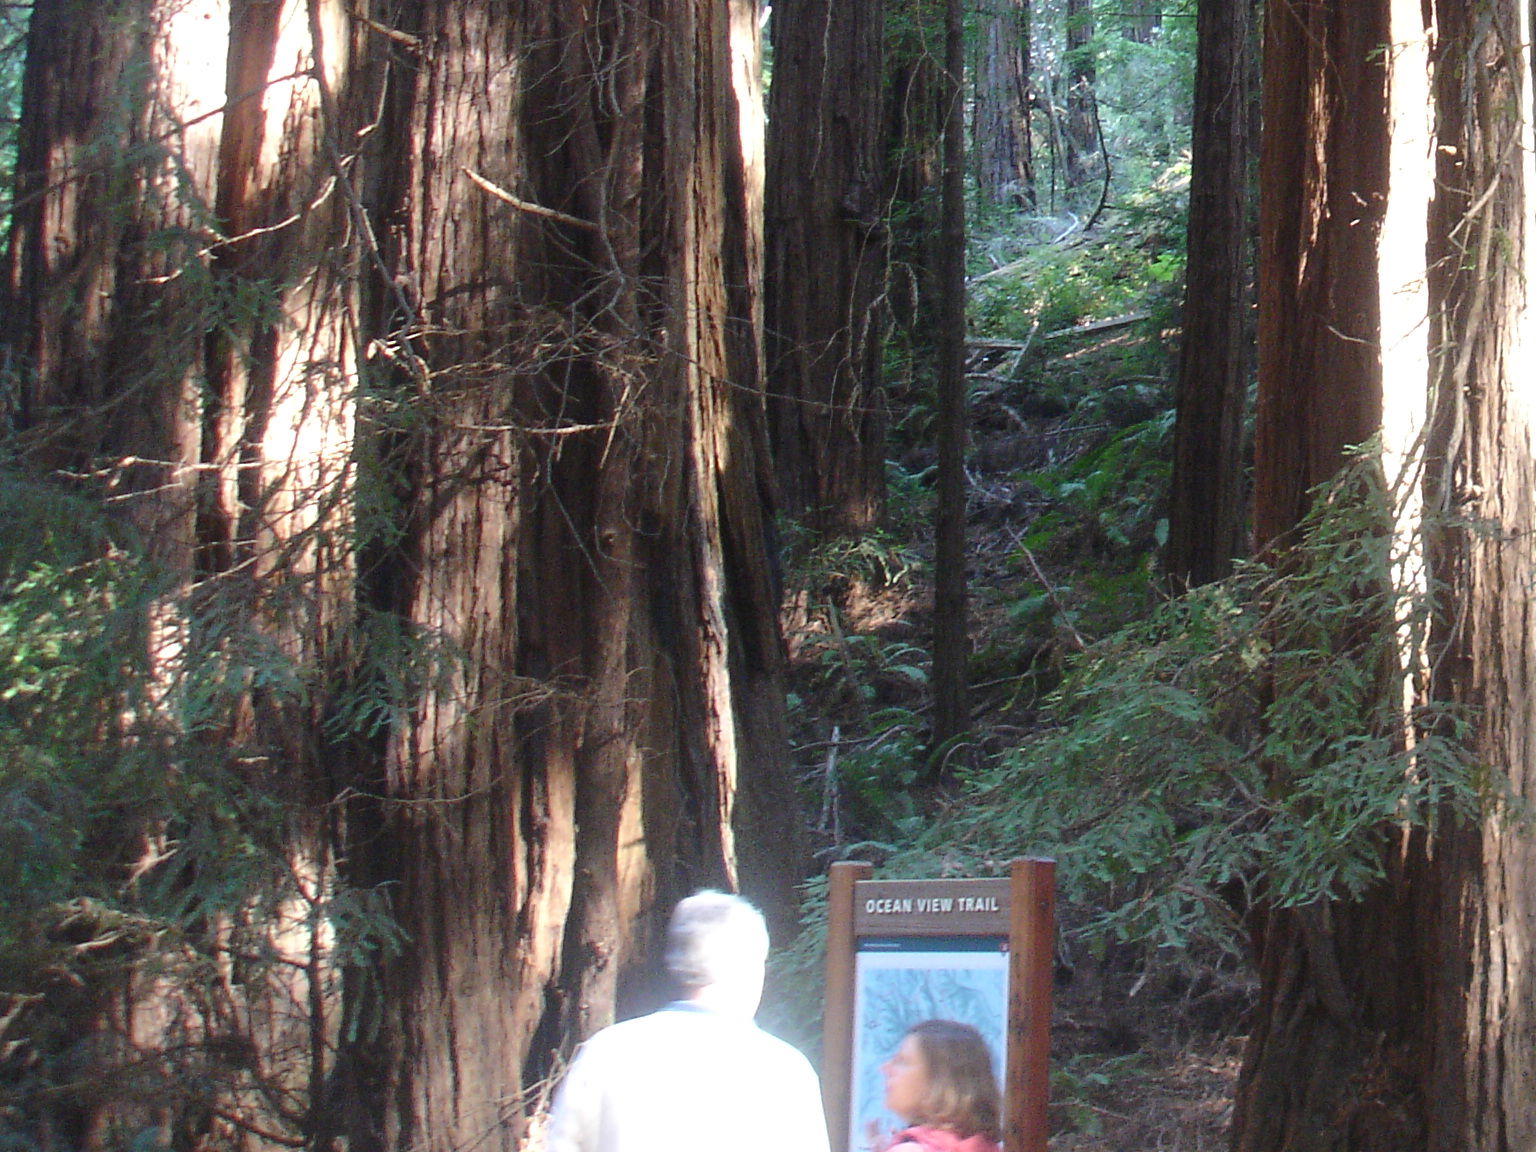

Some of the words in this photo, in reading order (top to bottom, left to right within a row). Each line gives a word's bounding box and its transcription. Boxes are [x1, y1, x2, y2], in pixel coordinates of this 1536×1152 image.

[865, 898, 913, 913] OCEAN
[917, 897, 953, 912] VIEW
[958, 896, 999, 911] TRAIL
